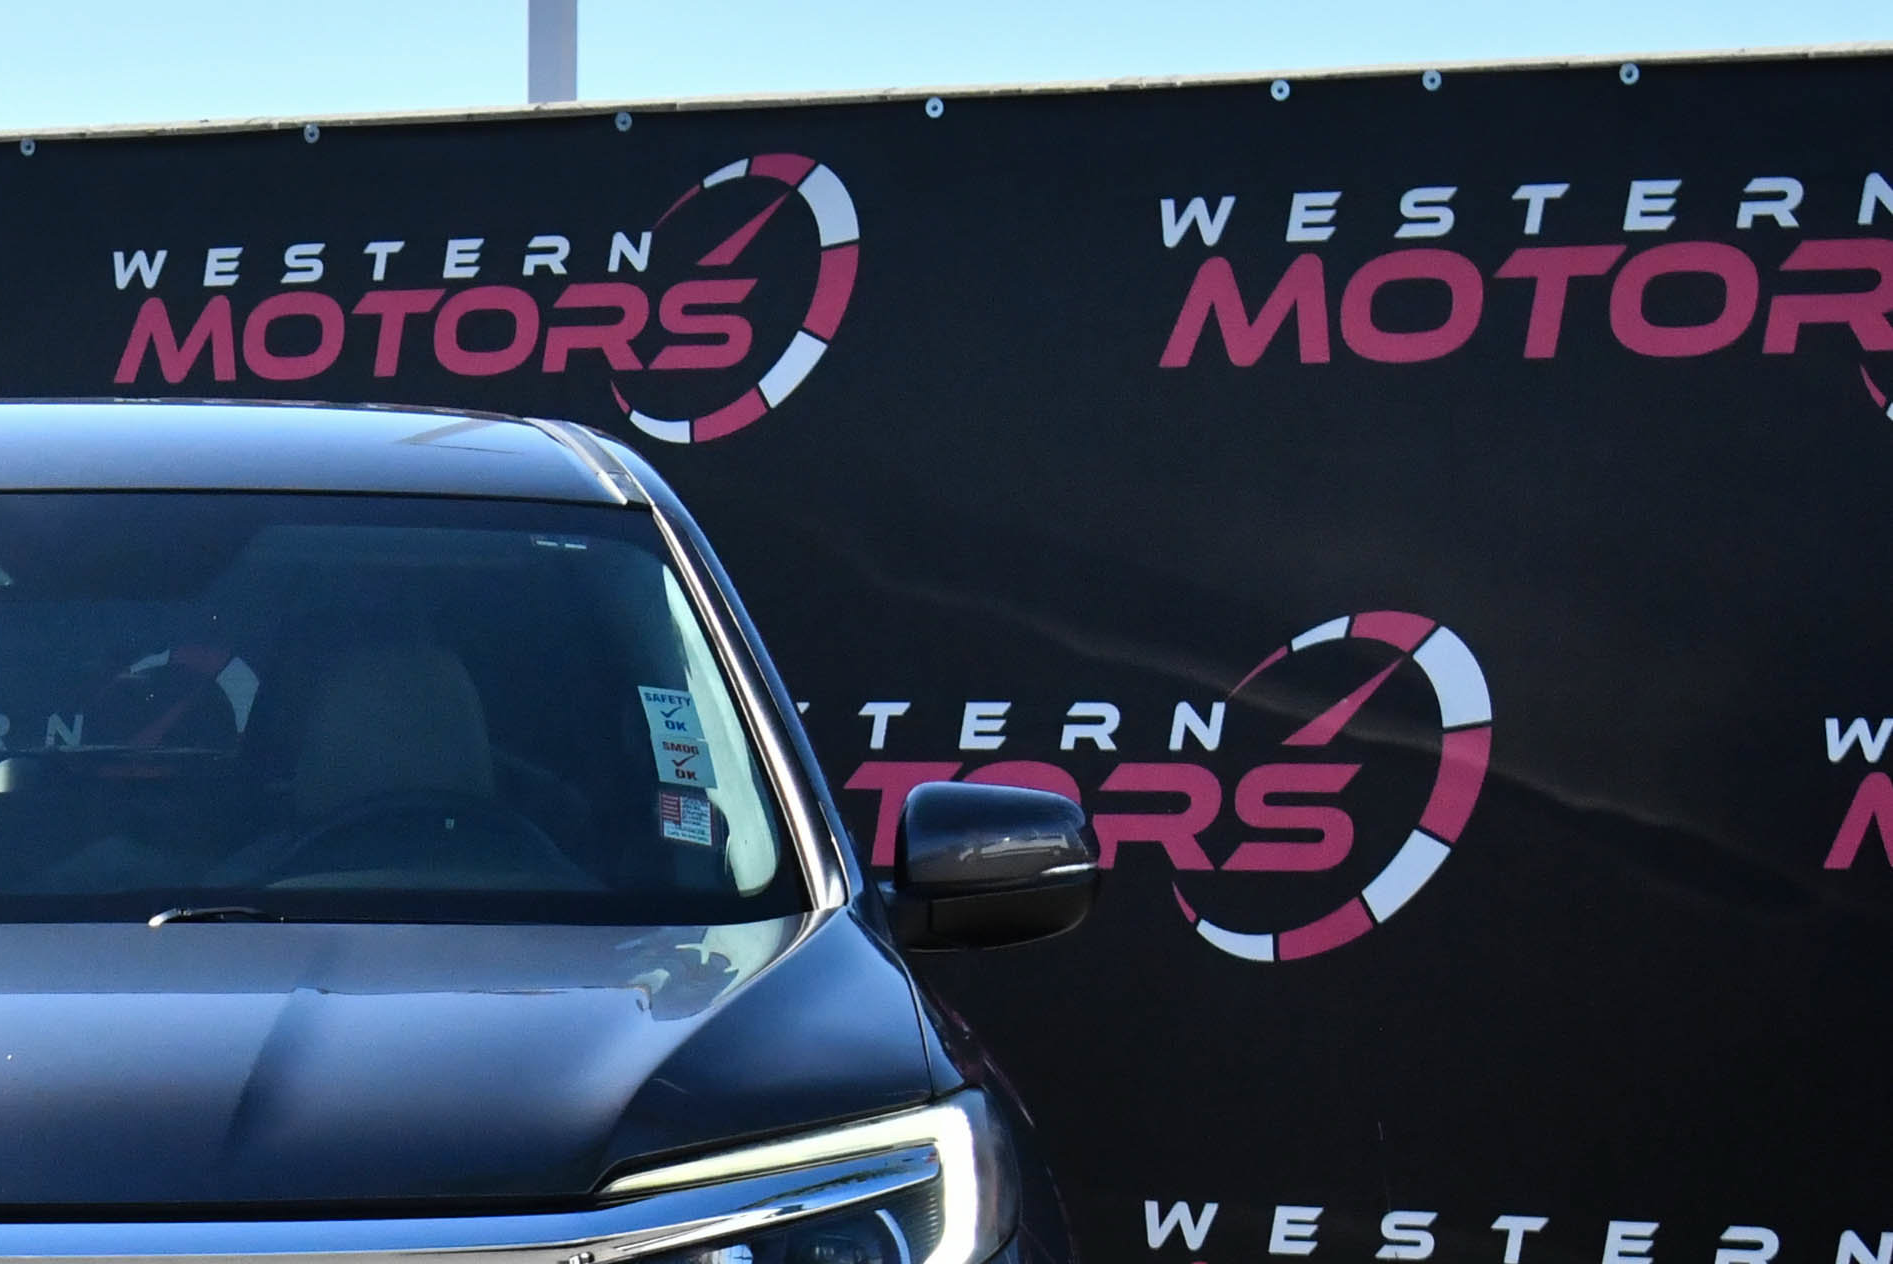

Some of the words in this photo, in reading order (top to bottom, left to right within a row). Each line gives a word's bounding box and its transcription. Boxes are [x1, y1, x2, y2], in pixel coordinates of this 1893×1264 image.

[112, 231, 652, 290] WESTERN
[113, 278, 758, 385] MOTORS
[643, 692, 691, 707] SAFETY
[664, 719, 687, 732] OK
[798, 701, 1226, 751] TERN
[662, 741, 699, 755] SMOG
[675, 768, 697, 781] OK
